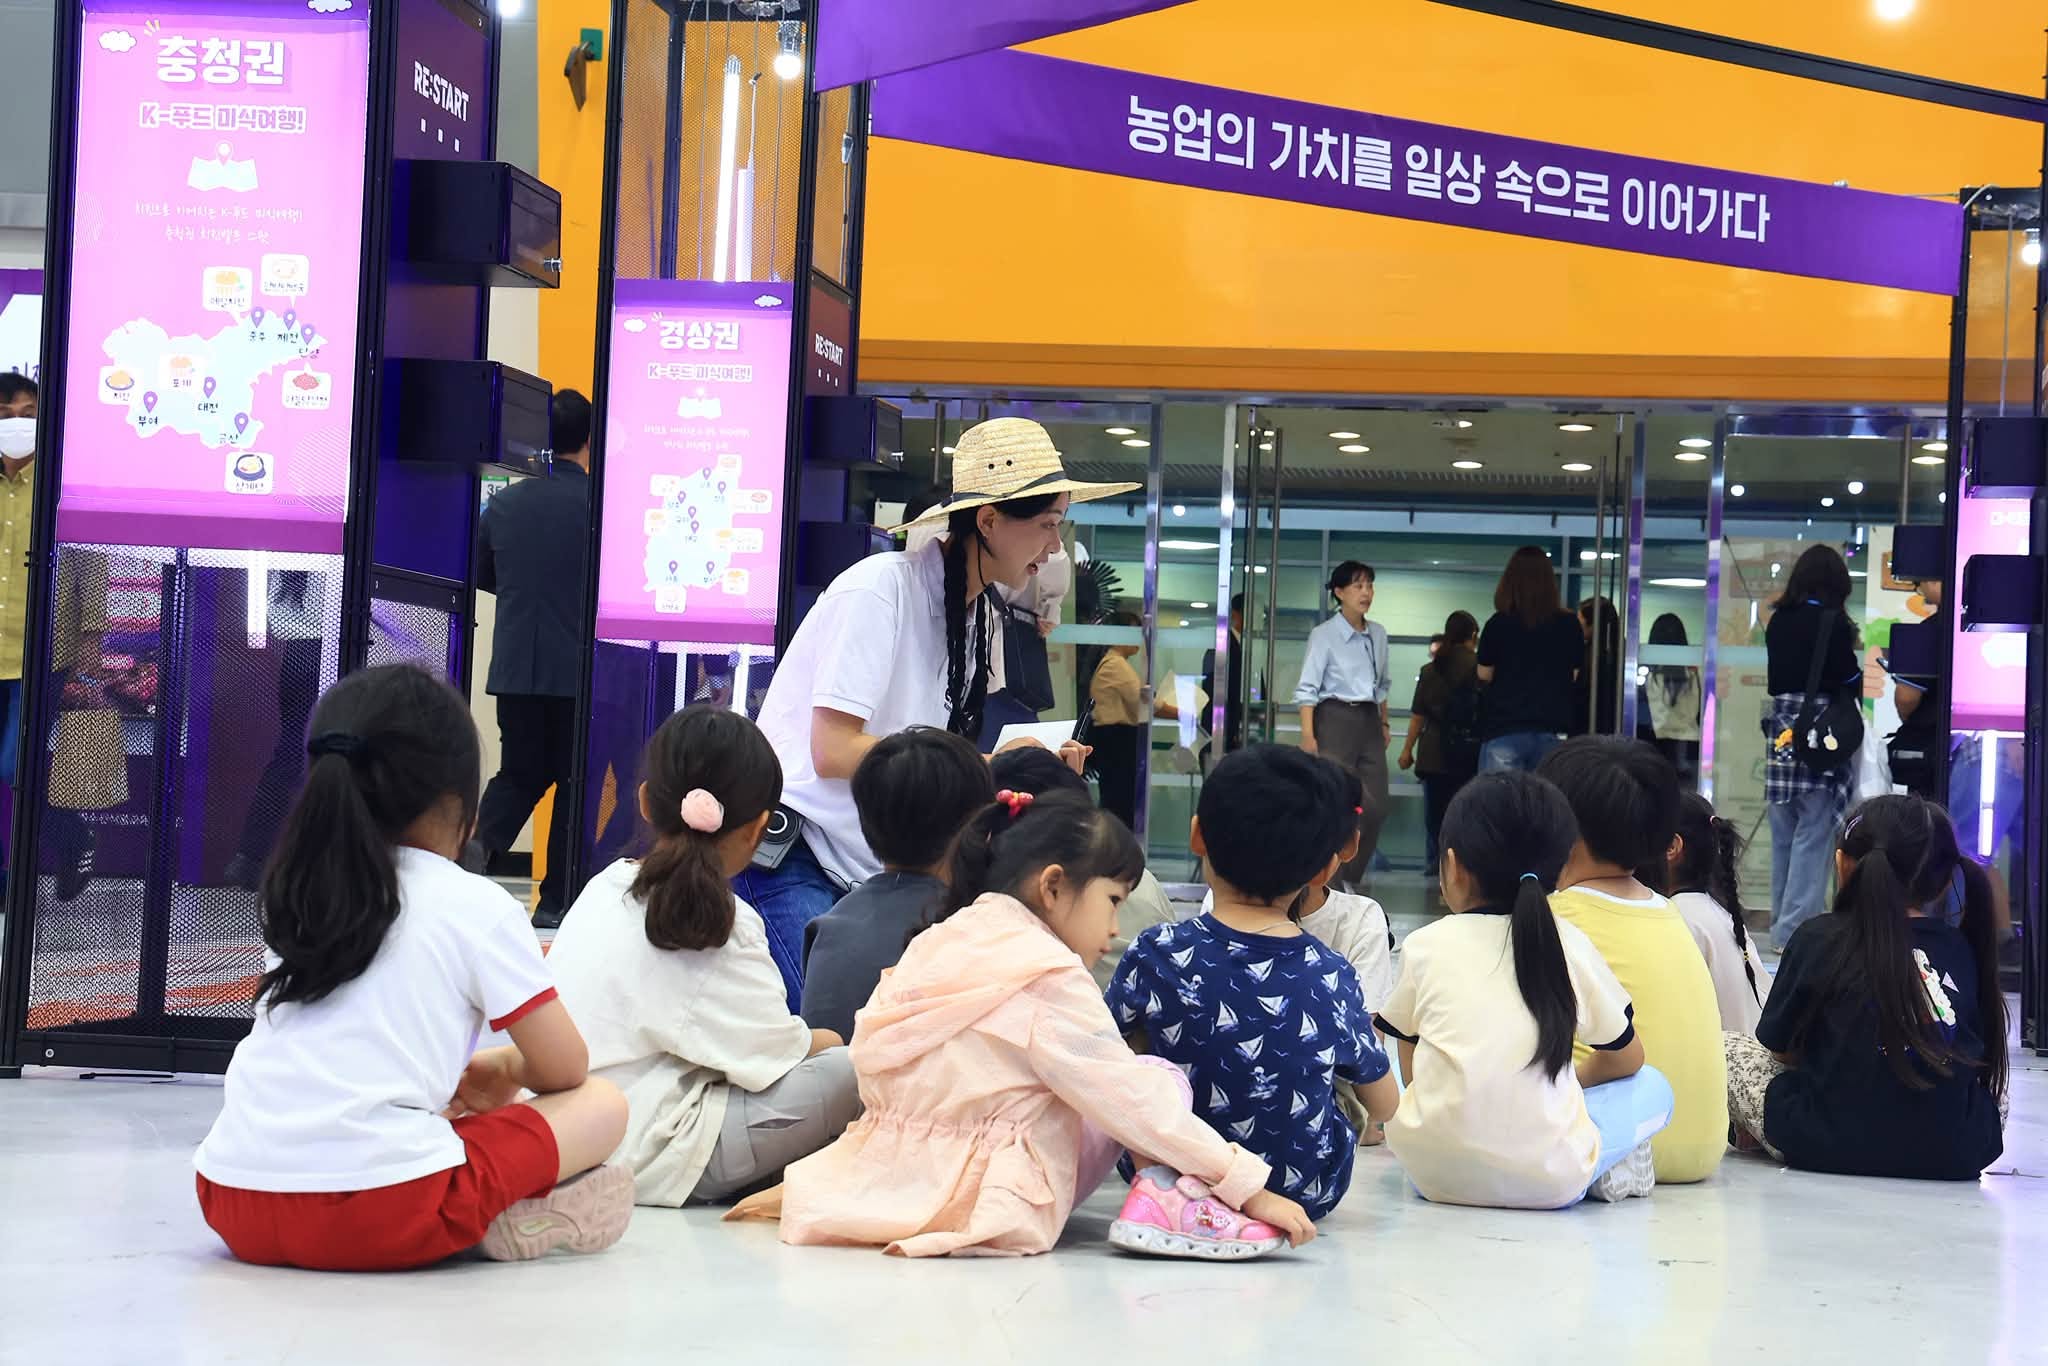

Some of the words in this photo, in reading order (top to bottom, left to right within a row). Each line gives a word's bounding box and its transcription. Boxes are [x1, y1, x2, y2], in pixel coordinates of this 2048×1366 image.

[157, 36, 285, 86] 충청권
[414, 60, 469, 121] RE:START
[140, 102, 214, 128] K-푸드
[215, 105, 306, 133] 미식여행!
[1127, 95, 1255, 170] 농업의
[1269, 121, 1393, 191] 가치를
[1405, 144, 1486, 205] 일상
[1495, 160, 1610, 222] 속으로
[1622, 178, 1771, 243] 이어가다
[659, 320, 740, 350] 경상권
[648, 361, 695, 380] K-푸드
[138, 415, 158, 427] 부여
[197, 402, 219, 414] 대전
